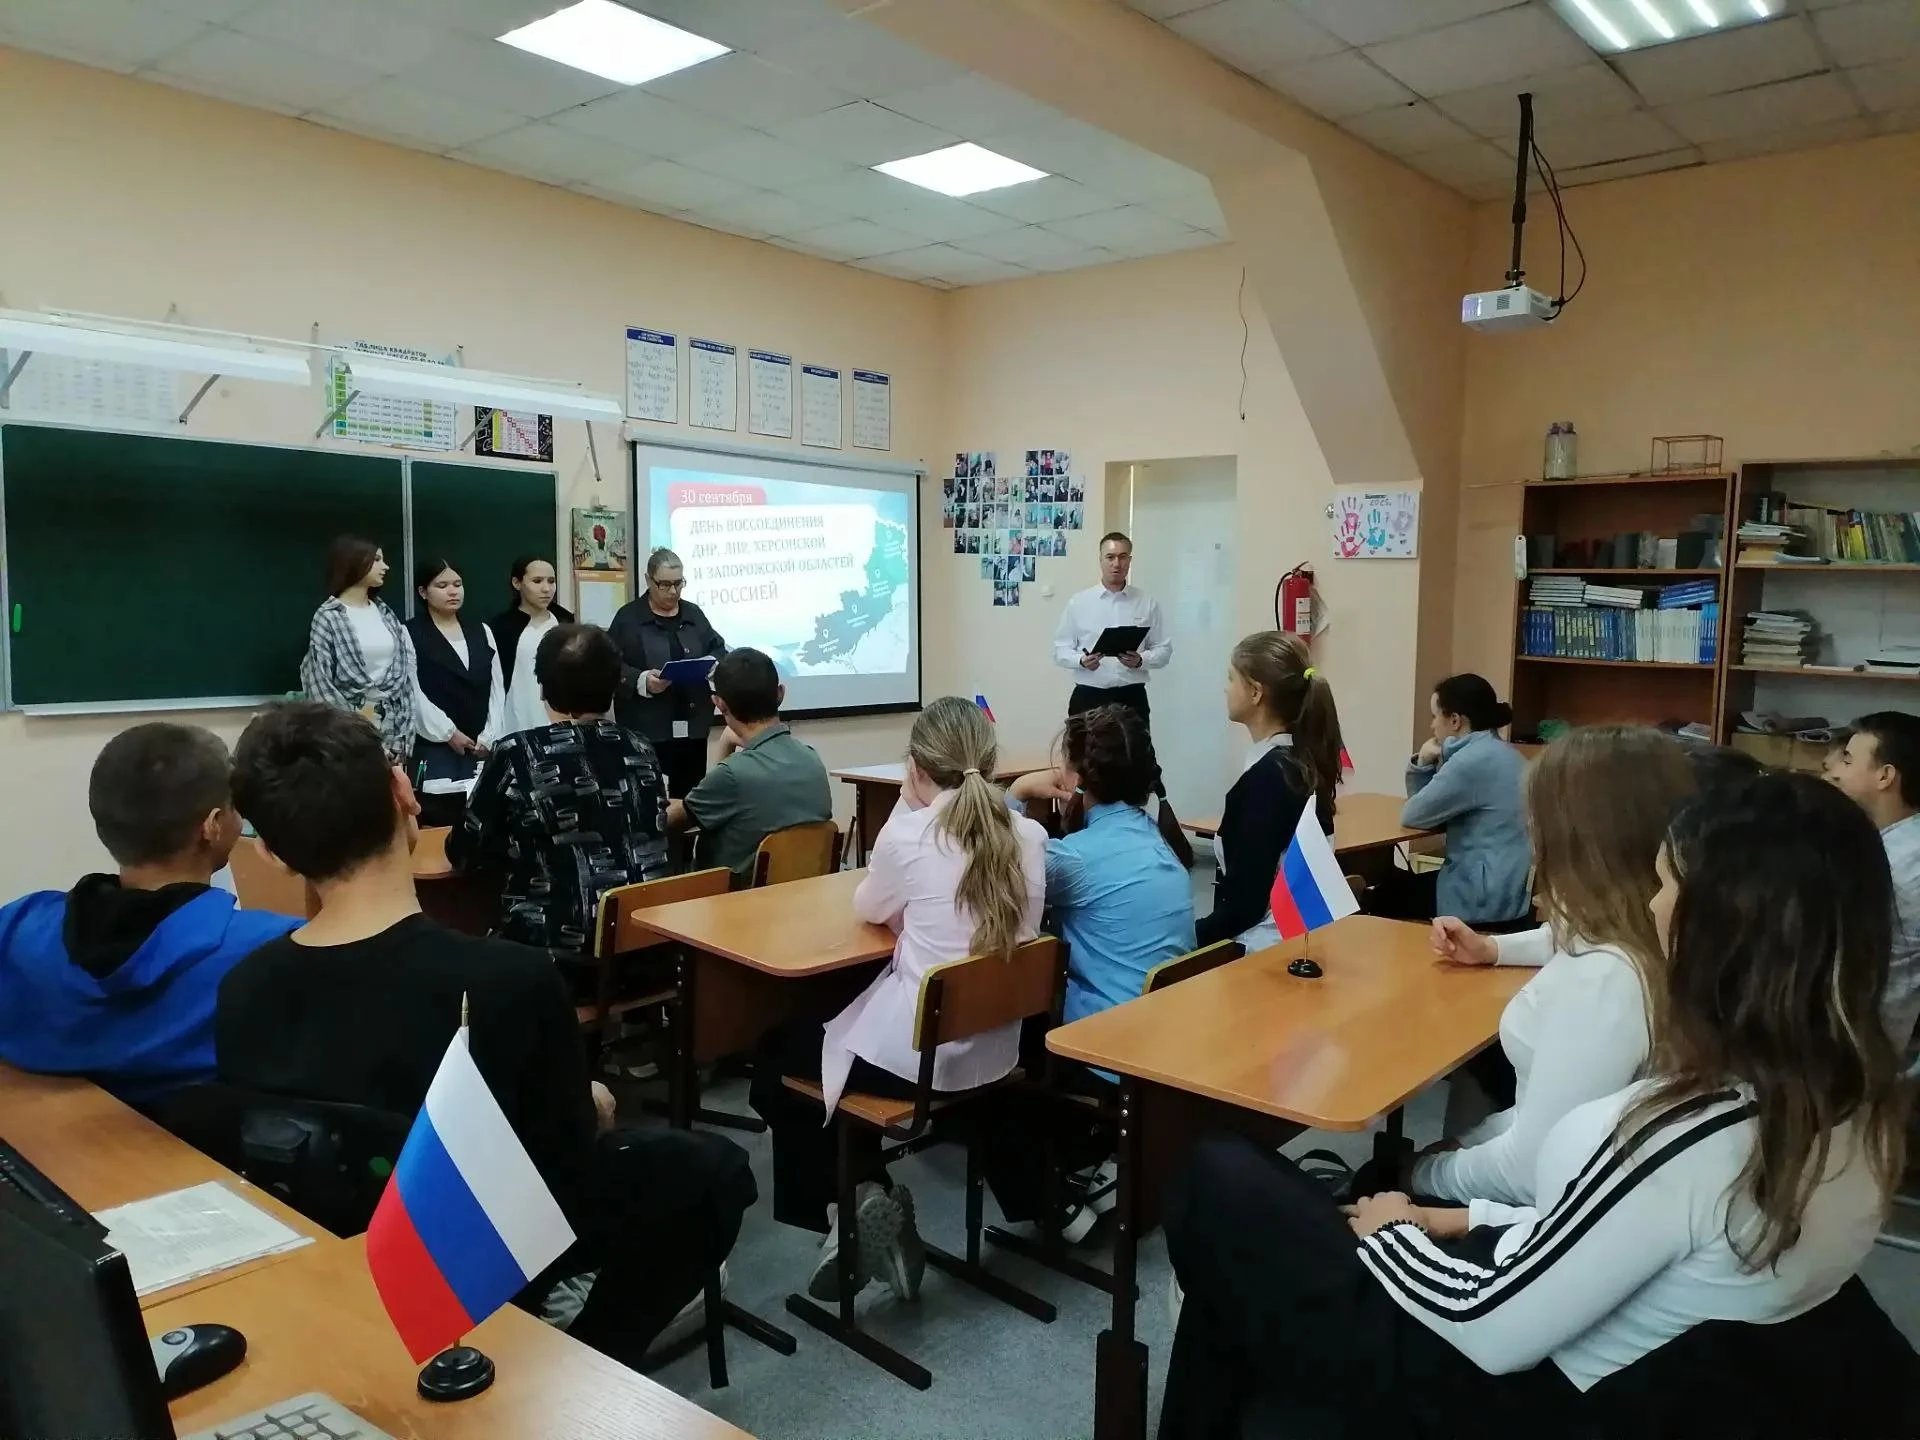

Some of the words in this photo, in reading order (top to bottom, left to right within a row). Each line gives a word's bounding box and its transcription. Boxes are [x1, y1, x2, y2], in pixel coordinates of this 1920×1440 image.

[681, 489, 696, 504] 30
[699, 491, 753, 507] сентября
[690, 520, 724, 535] ДЕНЬ
[727, 515, 825, 533] ВОССОЕДИНЕНИЯ
[754, 536, 826, 553] ХЕРСОНСКОЙ
[694, 567, 703, 581] И
[707, 559, 795, 580] ЗАПОРОЖСКОЙ
[798, 553, 854, 573] ОБЛАСТЕЙ
[696, 590, 706, 607] С
[710, 581, 778, 605] РОССИЕЙ
